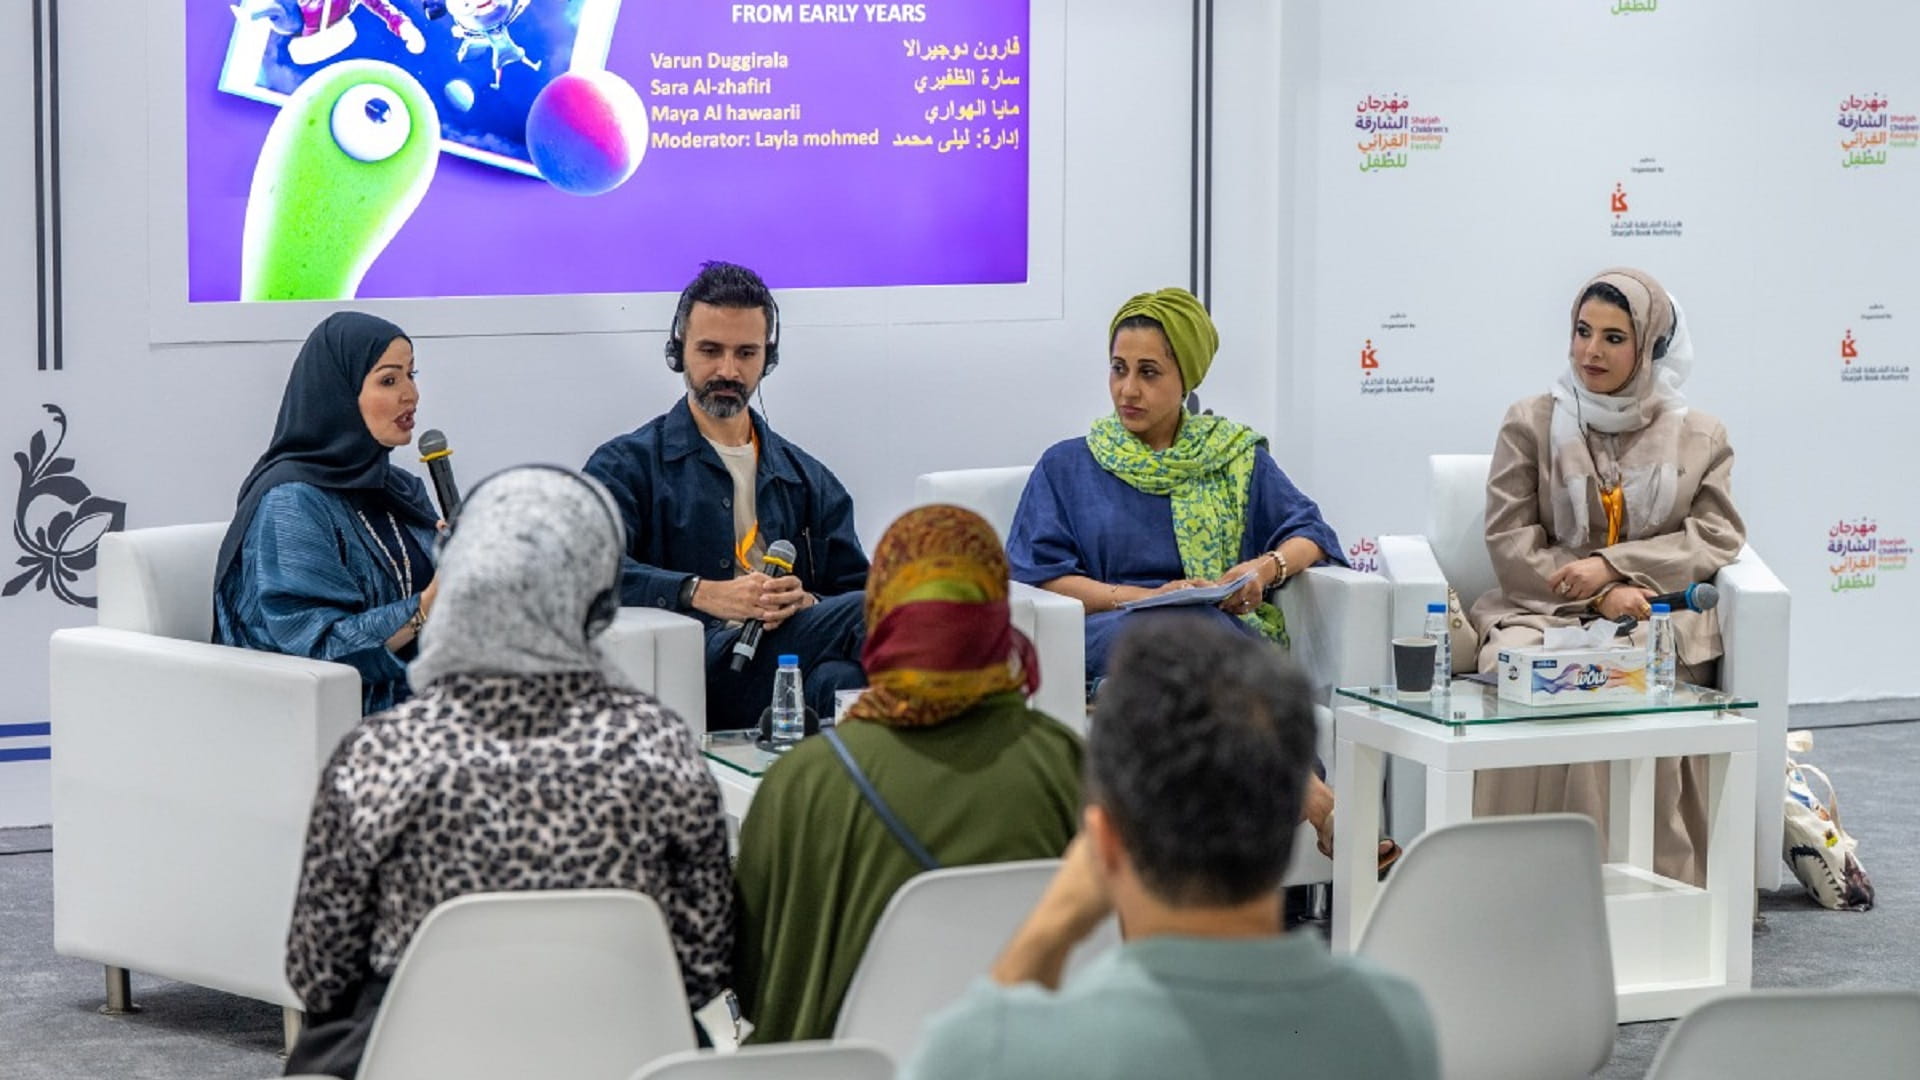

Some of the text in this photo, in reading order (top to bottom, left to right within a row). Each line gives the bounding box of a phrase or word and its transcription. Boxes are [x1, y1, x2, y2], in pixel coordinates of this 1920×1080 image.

[731, 4, 927, 23] FROM EARLY YEARS
[650, 51, 789, 72] Varun Duggirala
[650, 77, 771, 96] Sara Al-zhafiri
[981, 68, 1020, 91] سارة
[651, 103, 801, 125] Maya Al hawaarii
[924, 98, 1020, 125] مايا الهواري
[651, 128, 879, 150] Moderator: Layla mohmed
[892, 133, 933, 147] محمد
